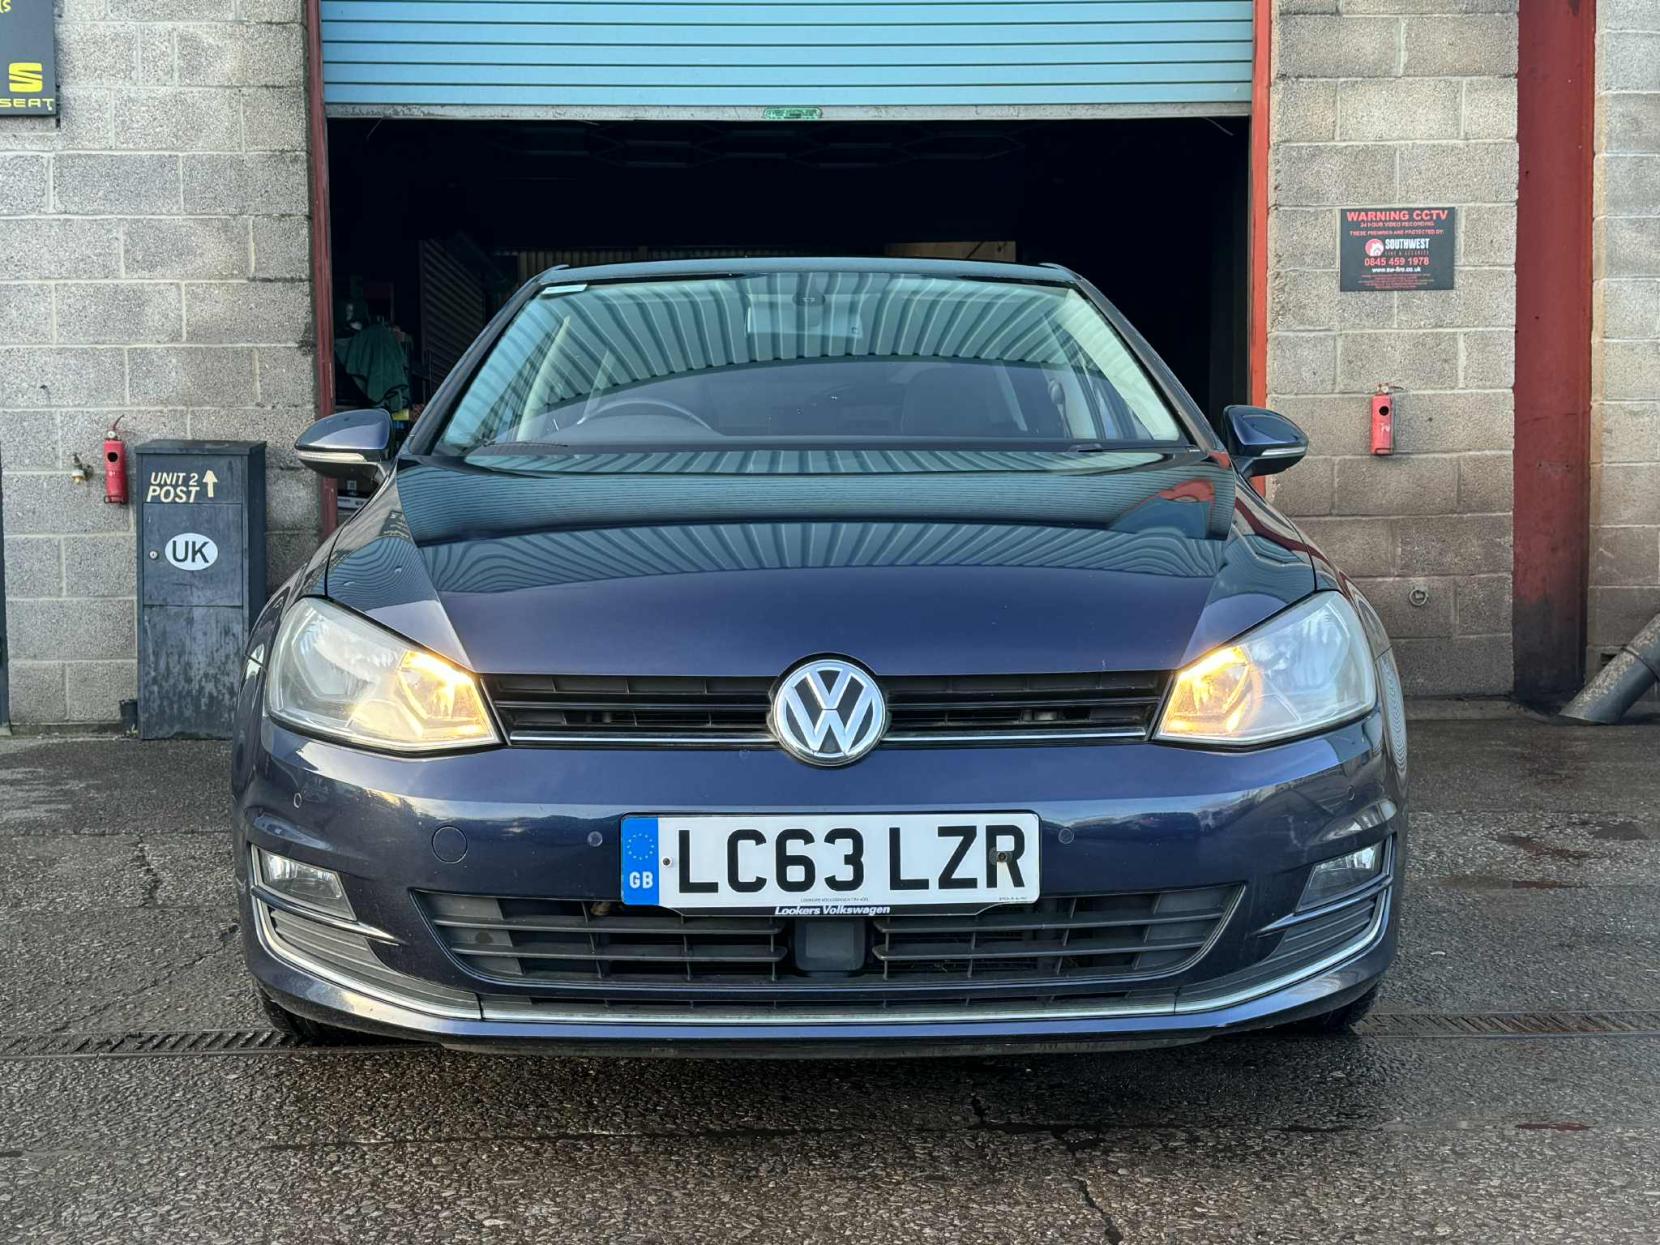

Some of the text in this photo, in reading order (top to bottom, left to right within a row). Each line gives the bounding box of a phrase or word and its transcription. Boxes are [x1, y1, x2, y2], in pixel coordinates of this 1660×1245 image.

[0, 98, 55, 108] SEAT
[1346, 210, 1448, 222] WARNING CCTV
[1385, 238, 1430, 250] SOUTHWEST
[1364, 256, 1429, 266] 0845 459 1978
[150, 472, 199, 486] UNIT 2
[146, 485, 200, 503] POST
[172, 540, 210, 564] UK
[678, 824, 1026, 894] LC63 LZR
[629, 871, 654, 889] GB
[774, 905, 891, 916] Lookers Volkswagen
